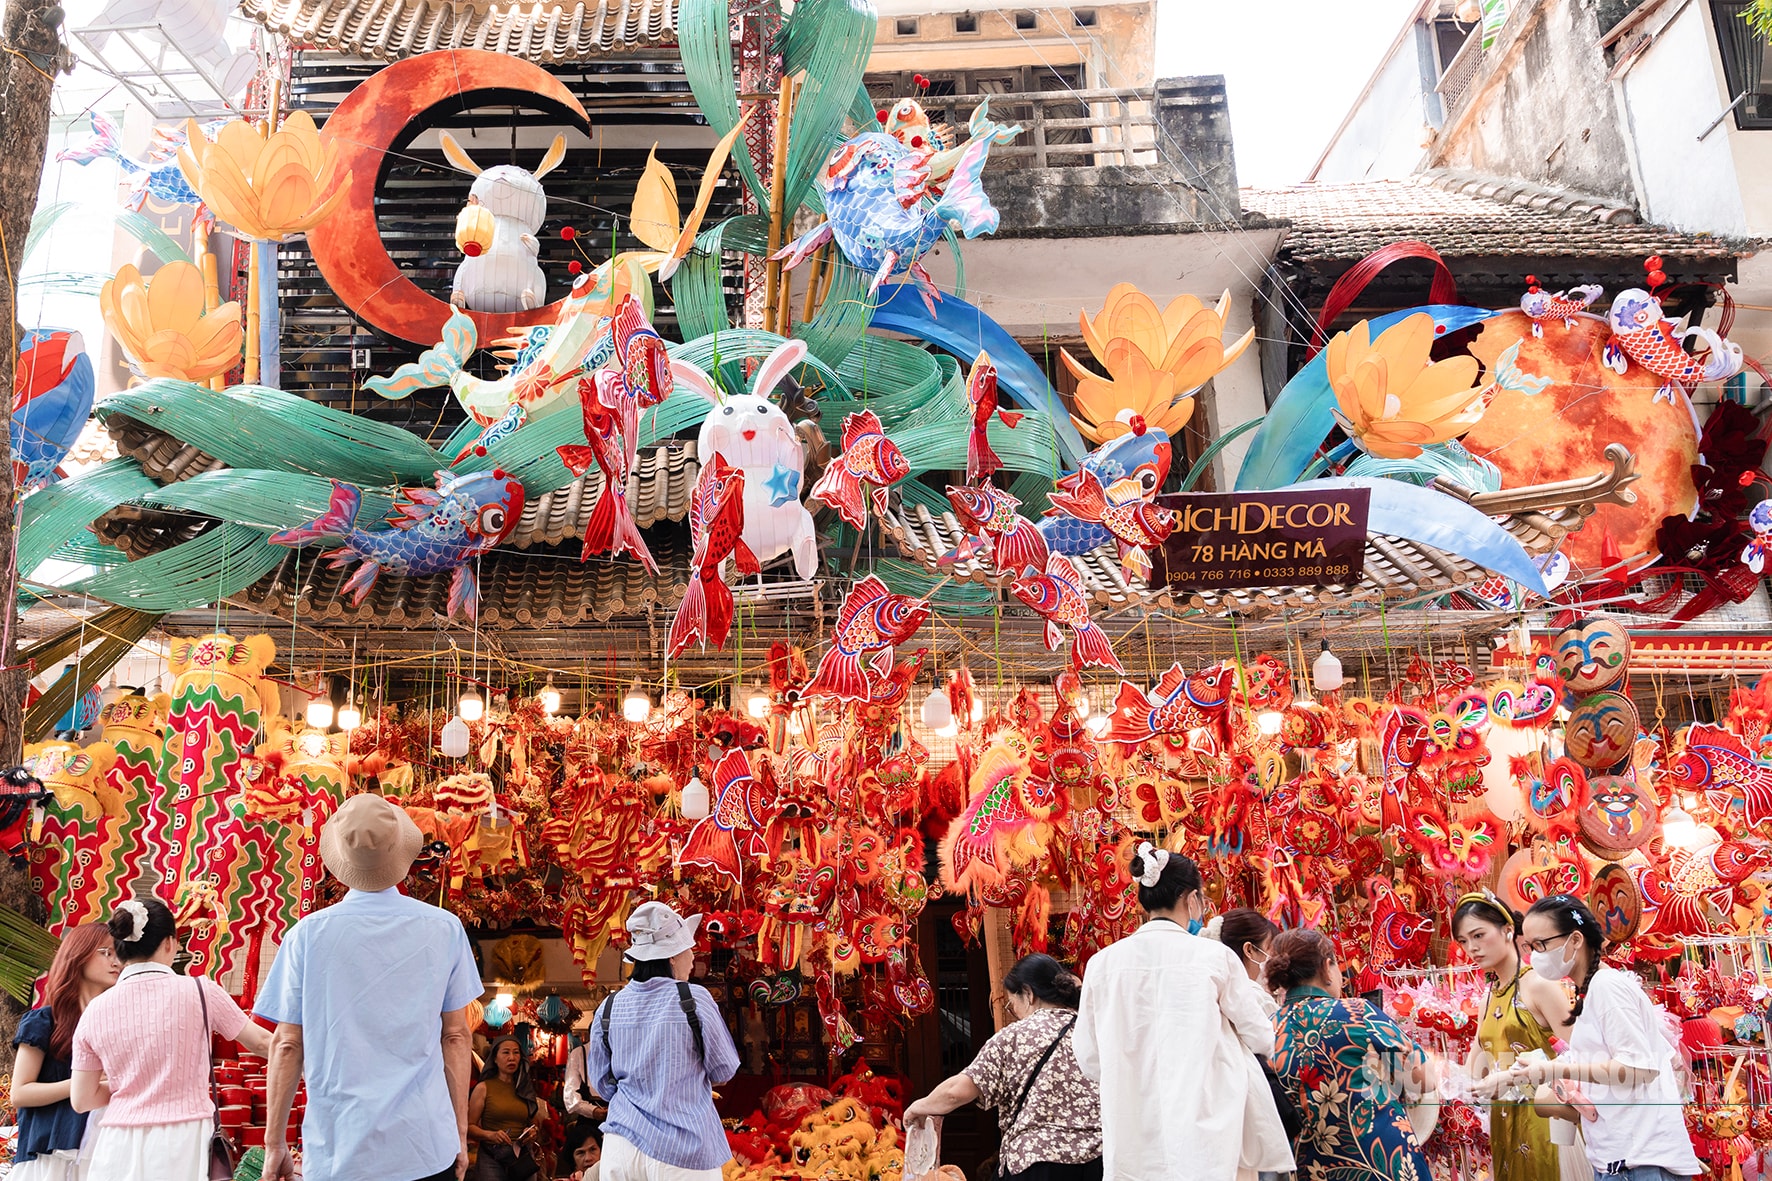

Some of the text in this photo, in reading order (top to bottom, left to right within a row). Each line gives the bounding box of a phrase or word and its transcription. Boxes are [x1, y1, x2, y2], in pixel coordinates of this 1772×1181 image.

[1191, 537, 1327, 563] 78 HÀNG MÃ
[1166, 564, 1349, 582] 0904 766 716 0333 889 888
